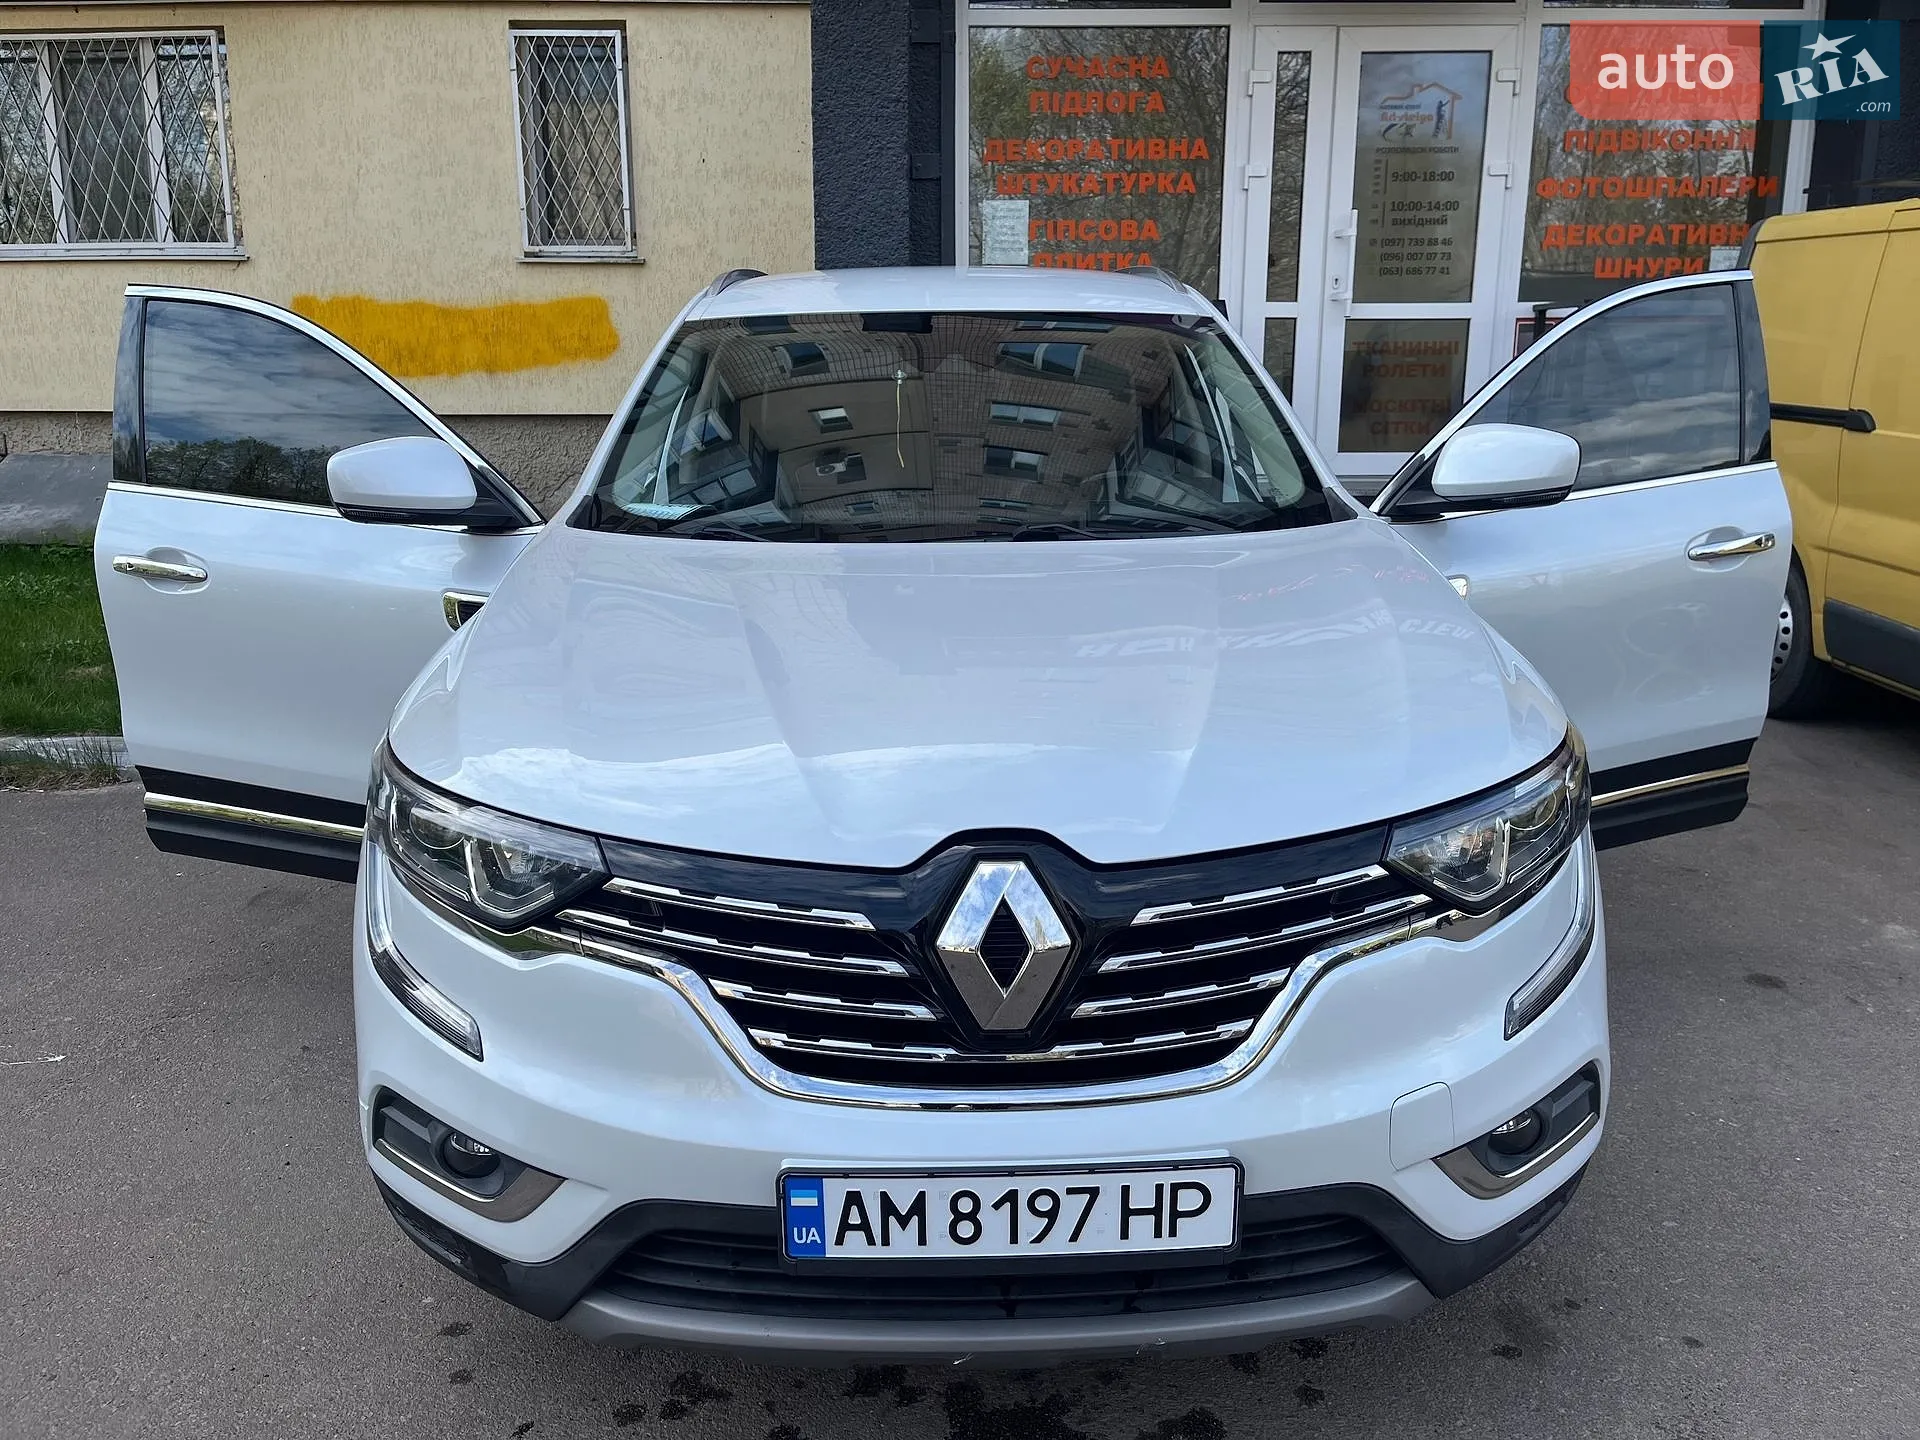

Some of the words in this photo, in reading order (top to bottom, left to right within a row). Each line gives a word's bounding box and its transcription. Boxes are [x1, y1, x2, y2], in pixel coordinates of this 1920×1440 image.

[1026, 55, 1171, 80] СУЧАСНА
[1028, 90, 1167, 118] ПІДЛОГА
[982, 135, 1210, 165] ДЕКОРАТИВНА
[1563, 128, 1757, 155] ПІДВІКОННЯ
[995, 171, 1197, 196] ШТУКАТУРКА
[1391, 170, 1455, 182] 9:00-18:00
[1535, 175, 1779, 200] ФОТОШПАЛЕРИ
[1390, 200, 1460, 212] 10:00-14:00
[1028, 218, 1161, 242] ГІПСОВА
[1541, 223, 1751, 251] ДЕКОРАТИВН
[1594, 256, 1705, 279] ШНУРИ
[1363, 362, 1447, 379] РОЛЕТИ
[833, 1189, 928, 1247] AM
[948, 1186, 1101, 1246] 8197
[1120, 1181, 1212, 1241] HP
[793, 1226, 821, 1244] UA
